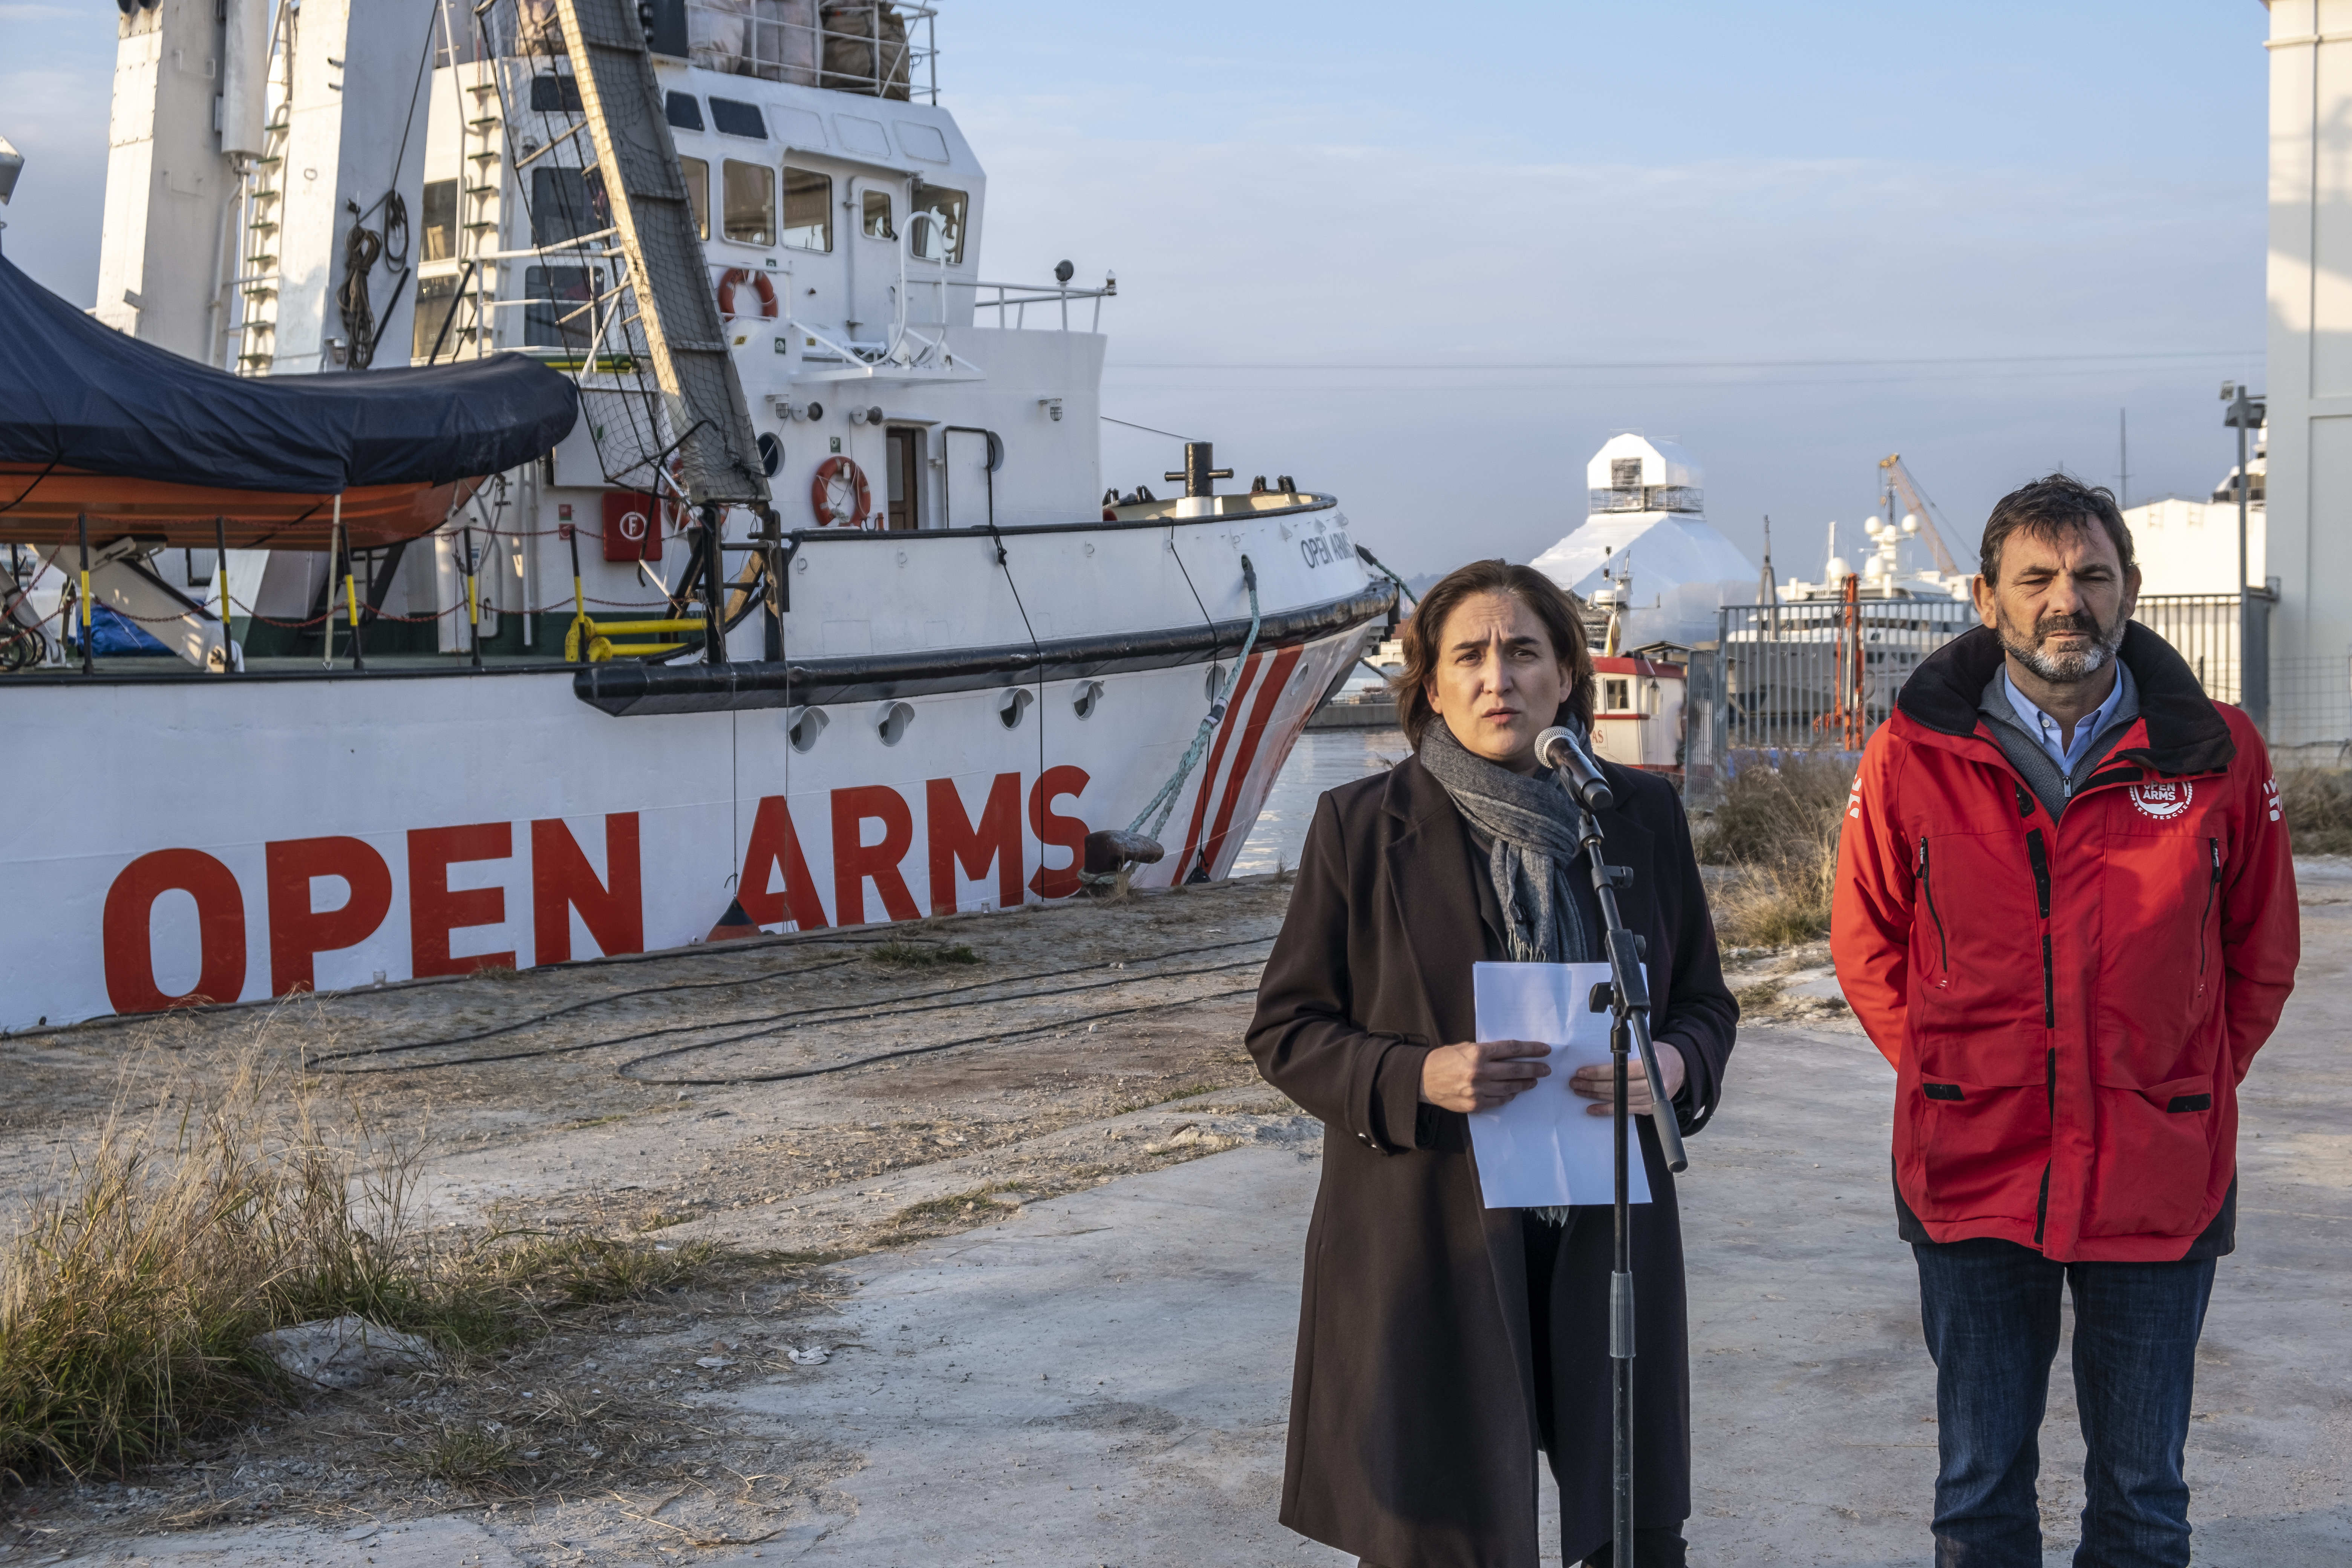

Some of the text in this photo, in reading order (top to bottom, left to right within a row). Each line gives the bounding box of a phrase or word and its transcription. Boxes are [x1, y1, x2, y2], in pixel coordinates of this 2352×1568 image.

[1301, 531, 1354, 568] OPEN ARMS
[2143, 790, 2176, 801] ARMS
[2133, 802, 2188, 820] SEA RESCUE
[102, 764, 1091, 1014] OPEN ARMS
